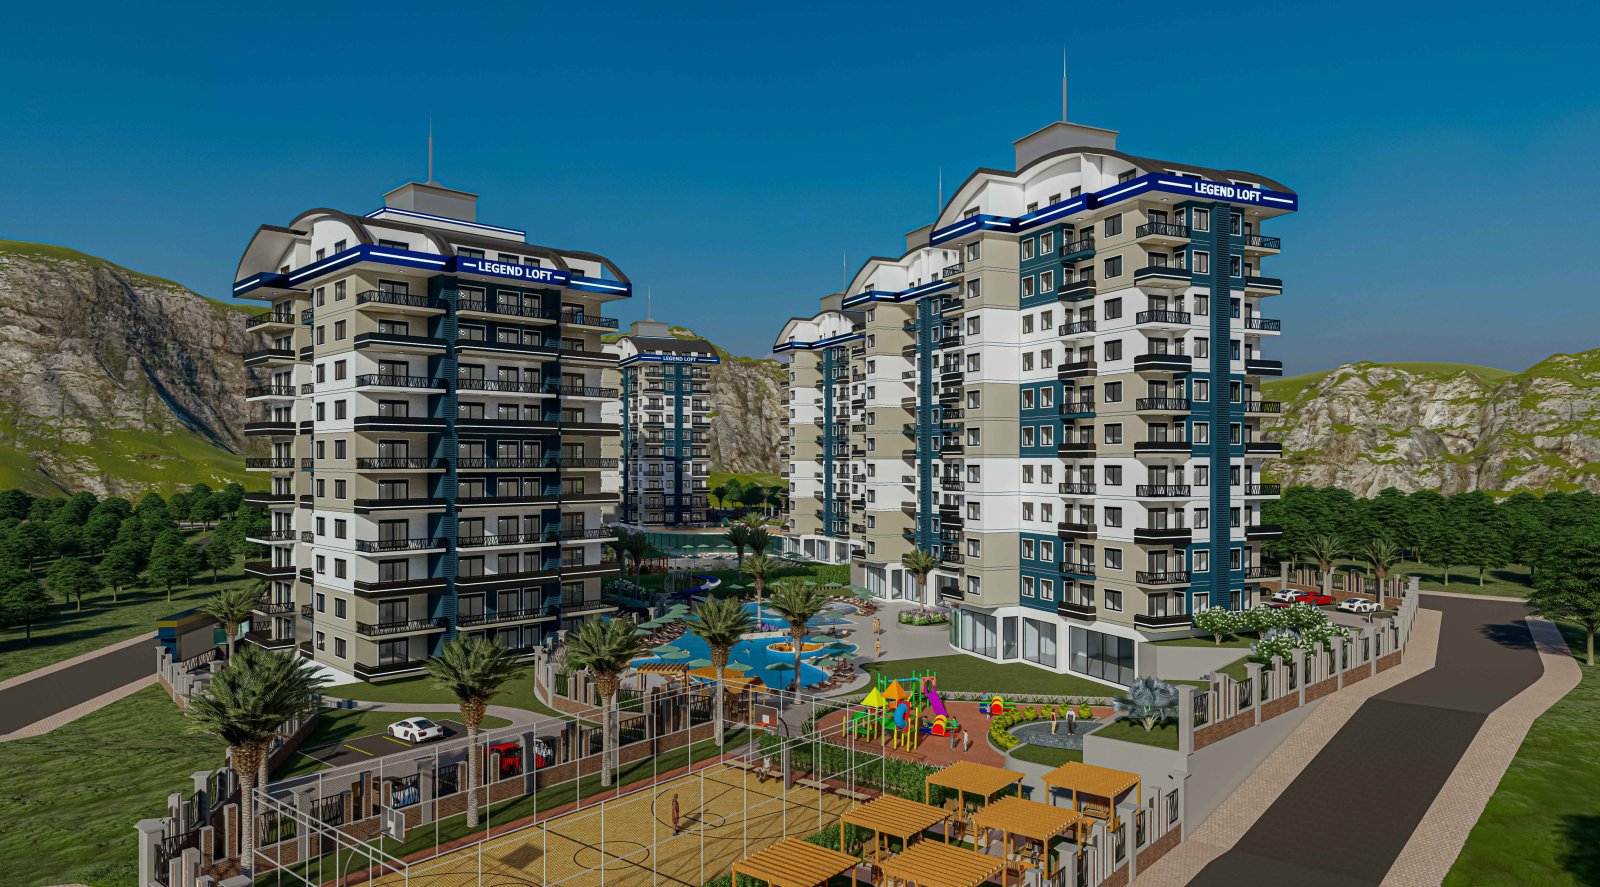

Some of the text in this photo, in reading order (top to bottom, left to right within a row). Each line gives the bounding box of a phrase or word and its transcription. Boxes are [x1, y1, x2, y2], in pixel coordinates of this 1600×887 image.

[1195, 182, 1261, 201] LEGEND LOFT
[478, 261, 552, 280] LEGEND LOFT
